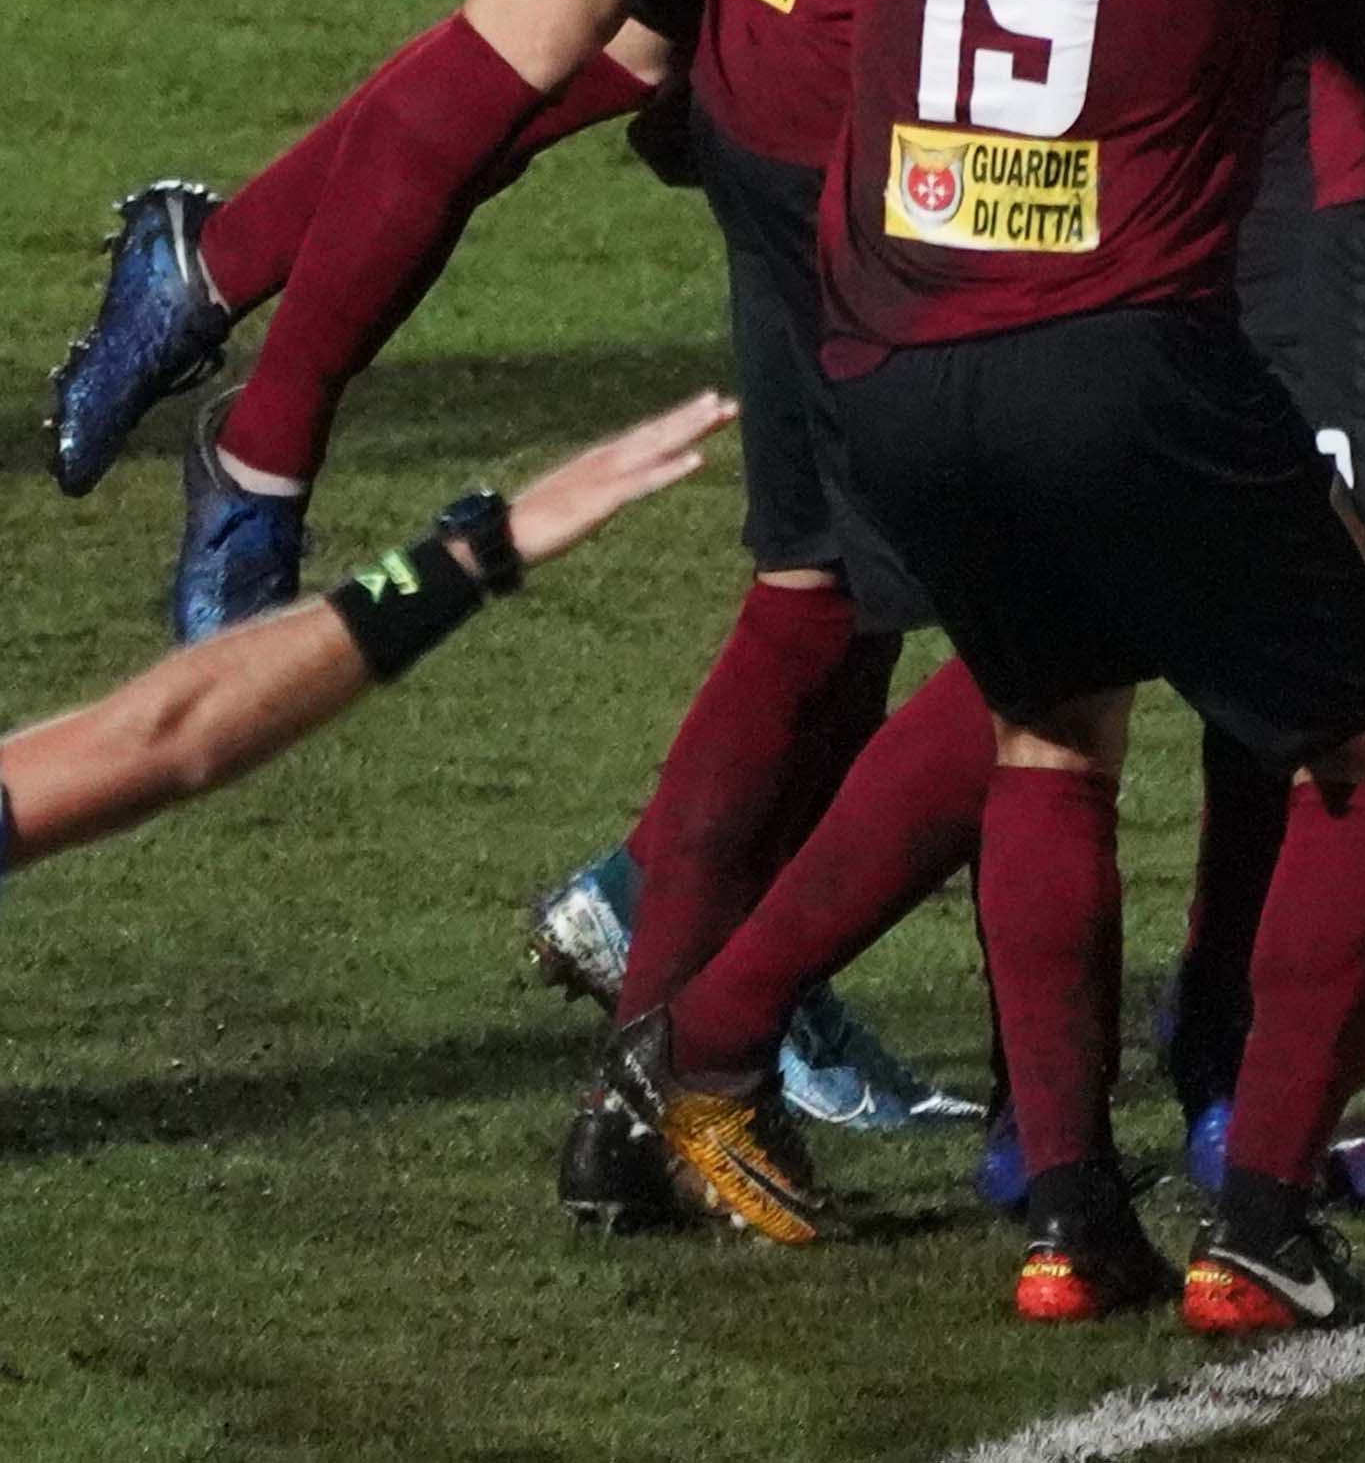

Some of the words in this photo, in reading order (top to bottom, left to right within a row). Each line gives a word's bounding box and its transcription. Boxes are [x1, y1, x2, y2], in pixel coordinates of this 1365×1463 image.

[971, 145, 1090, 188] GUARDIE
[973, 203, 998, 238] DI
[1006, 192, 1084, 242] CITTÀ
